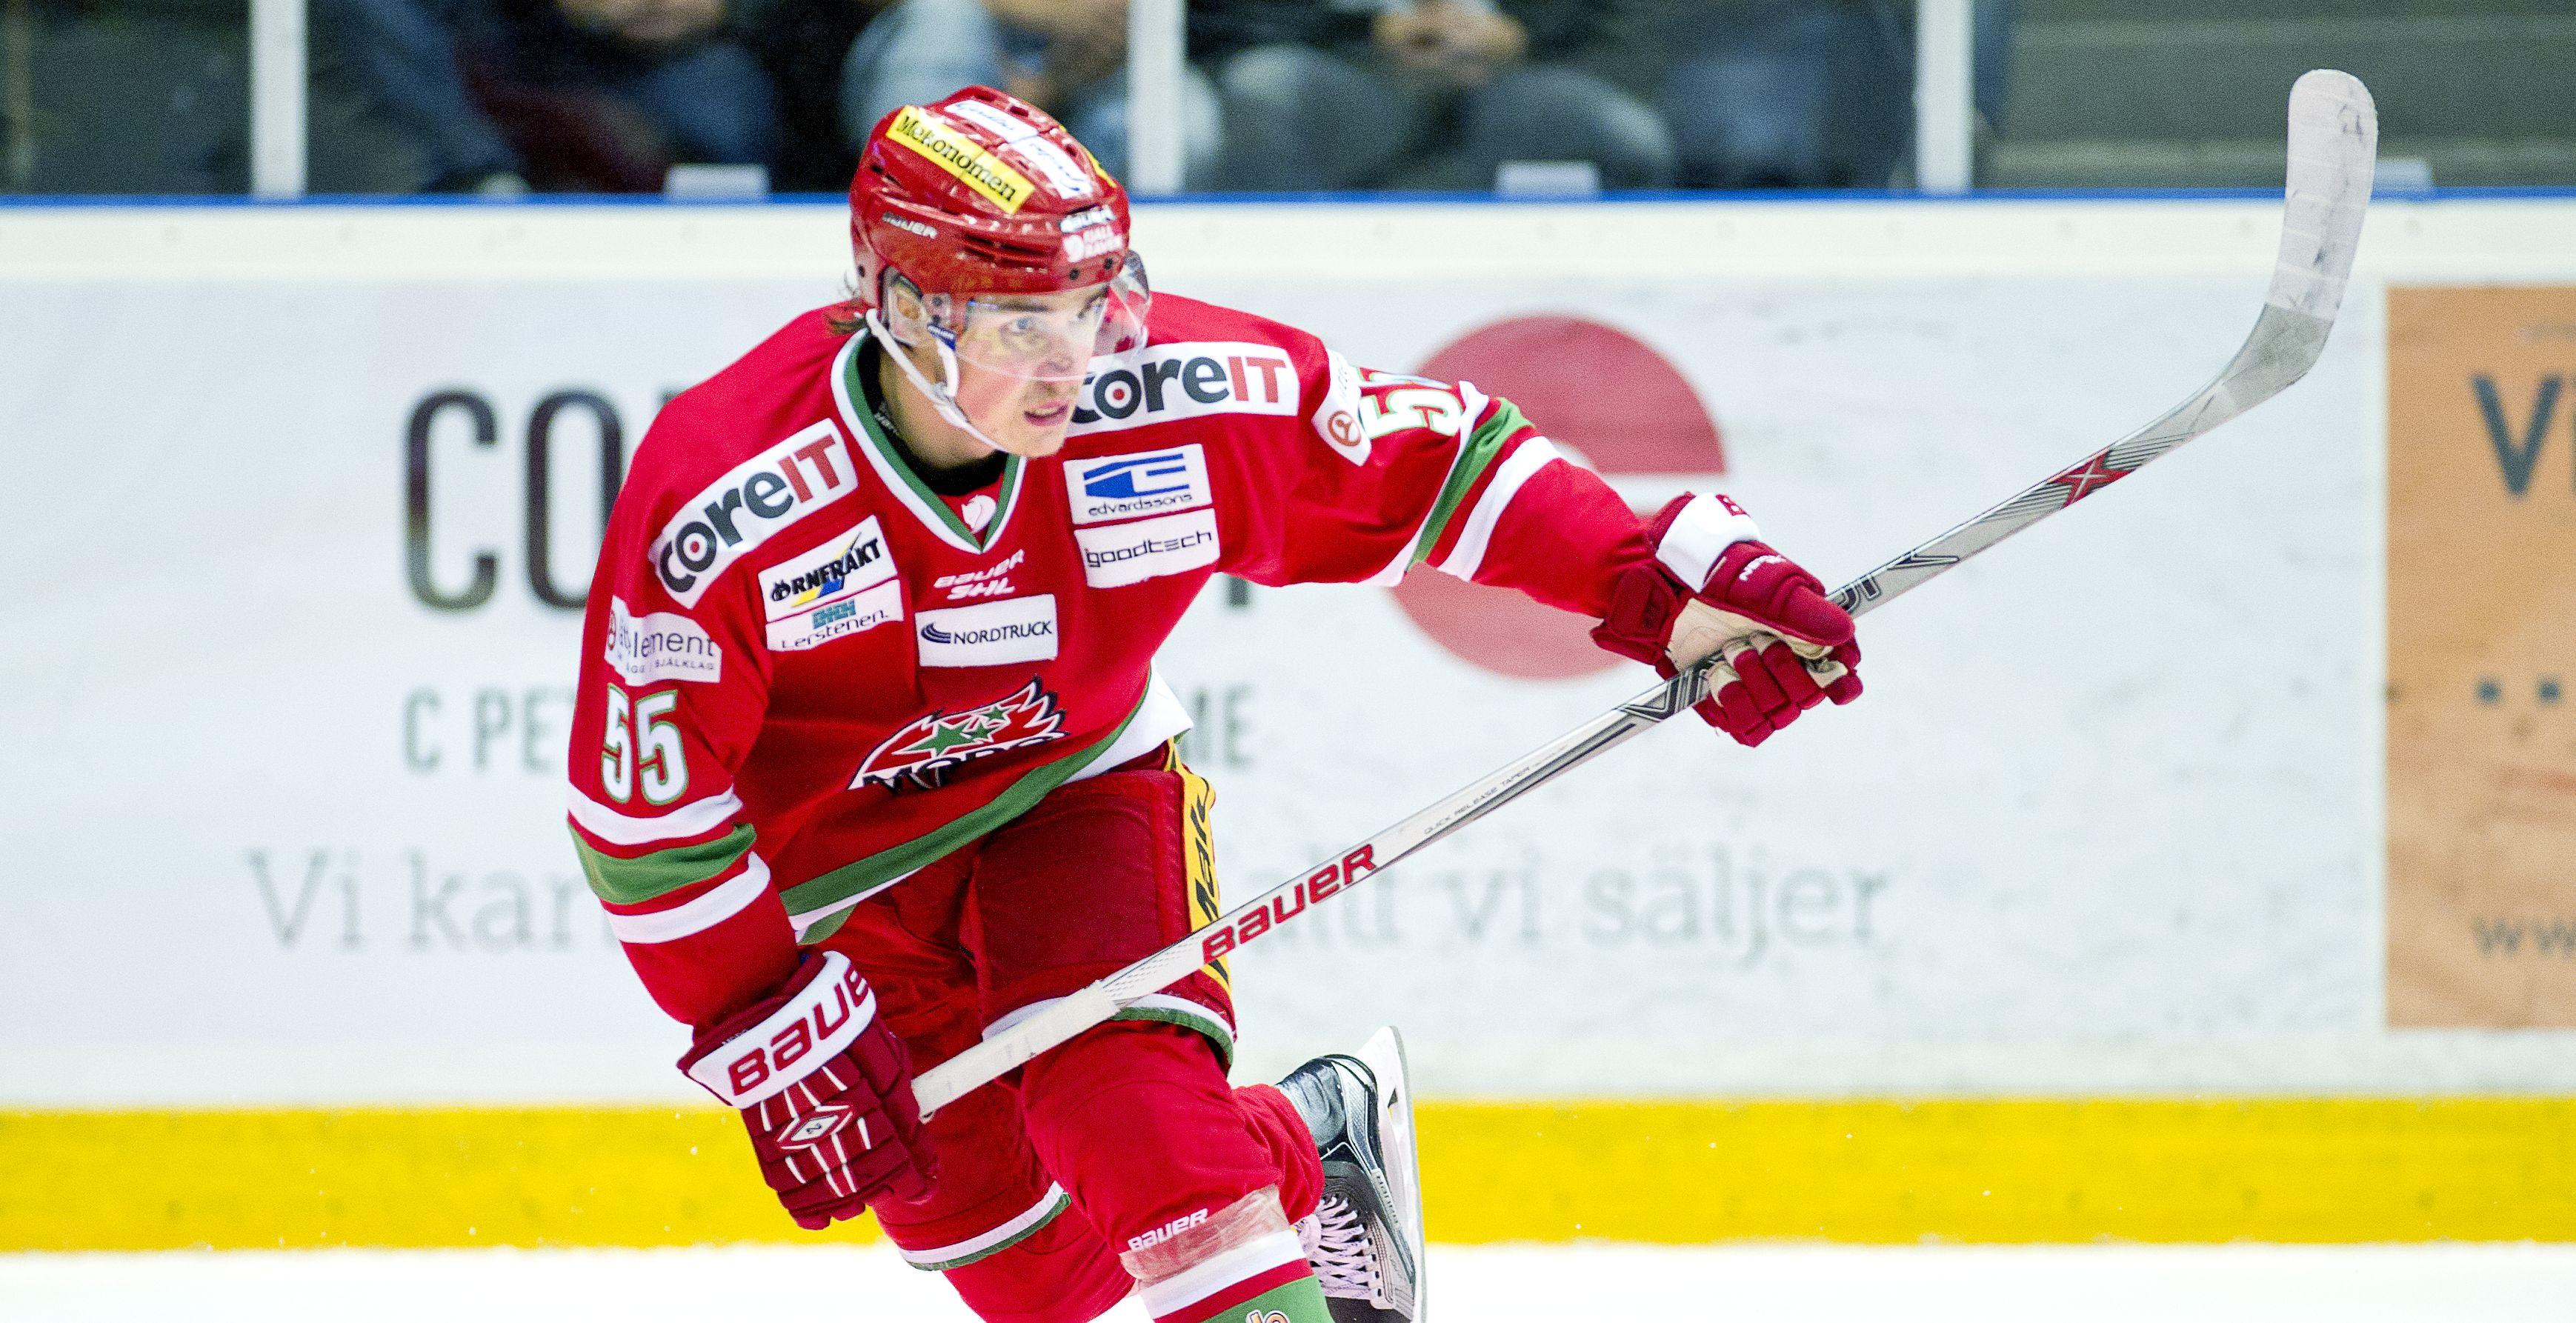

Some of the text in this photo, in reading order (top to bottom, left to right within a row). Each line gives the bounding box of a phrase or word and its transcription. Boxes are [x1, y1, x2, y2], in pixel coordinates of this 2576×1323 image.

[896, 114, 1016, 203] Mekonomen
[1088, 493, 1194, 516] edvardssons
[1085, 530, 1213, 568] goodtech
[947, 578, 1016, 600] SHL
[953, 620, 1054, 646] NORDTRUCK
[601, 683, 690, 806] 55
[1454, 787, 1498, 816] RELEASE
[1500, 766, 1530, 786] TAPER
[247, 845, 364, 949] Vi
[1581, 843, 1892, 967] säljer
